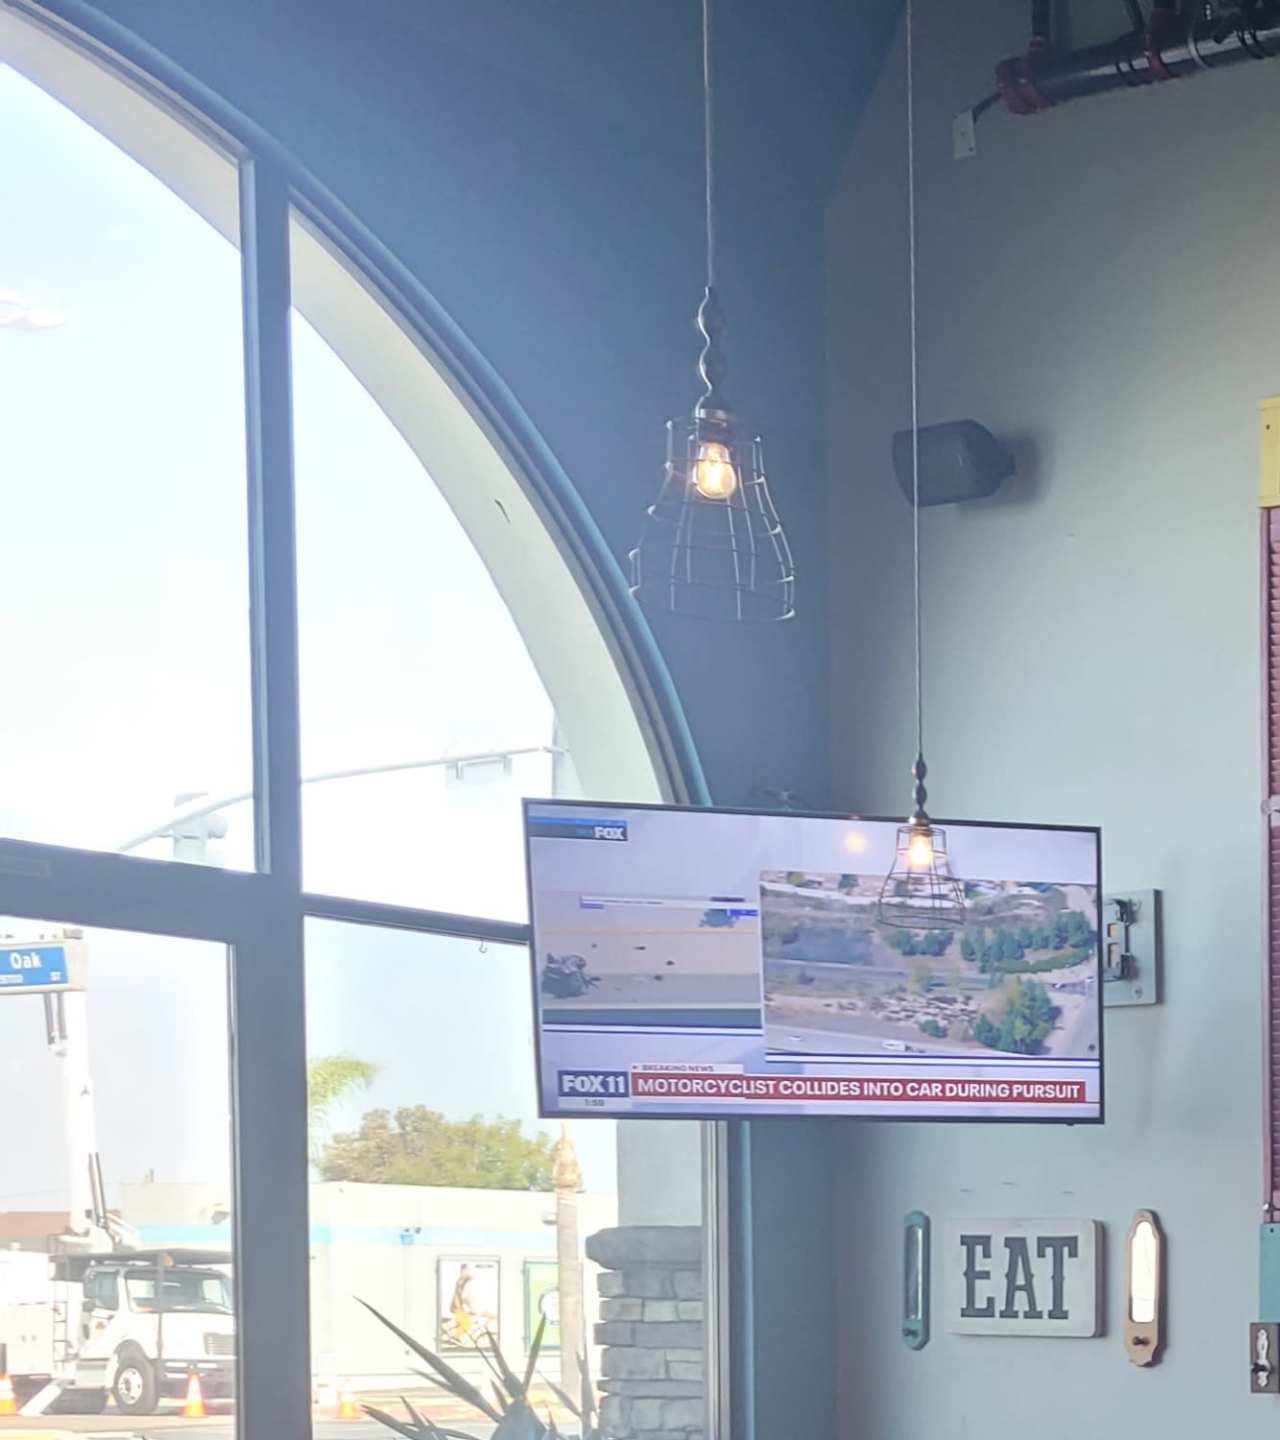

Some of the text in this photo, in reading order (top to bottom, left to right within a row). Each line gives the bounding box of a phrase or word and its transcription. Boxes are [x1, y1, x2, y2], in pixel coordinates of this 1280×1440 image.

[594, 825, 624, 840] FOX
[10, 952, 42, 969] Oak
[562, 1074, 625, 1094] FOX 11
[637, 1078, 1080, 1099] MOTORCYCLIST COLLIDES INTO CAR DURING PURSUIT
[960, 1234, 1079, 1320] EAT
